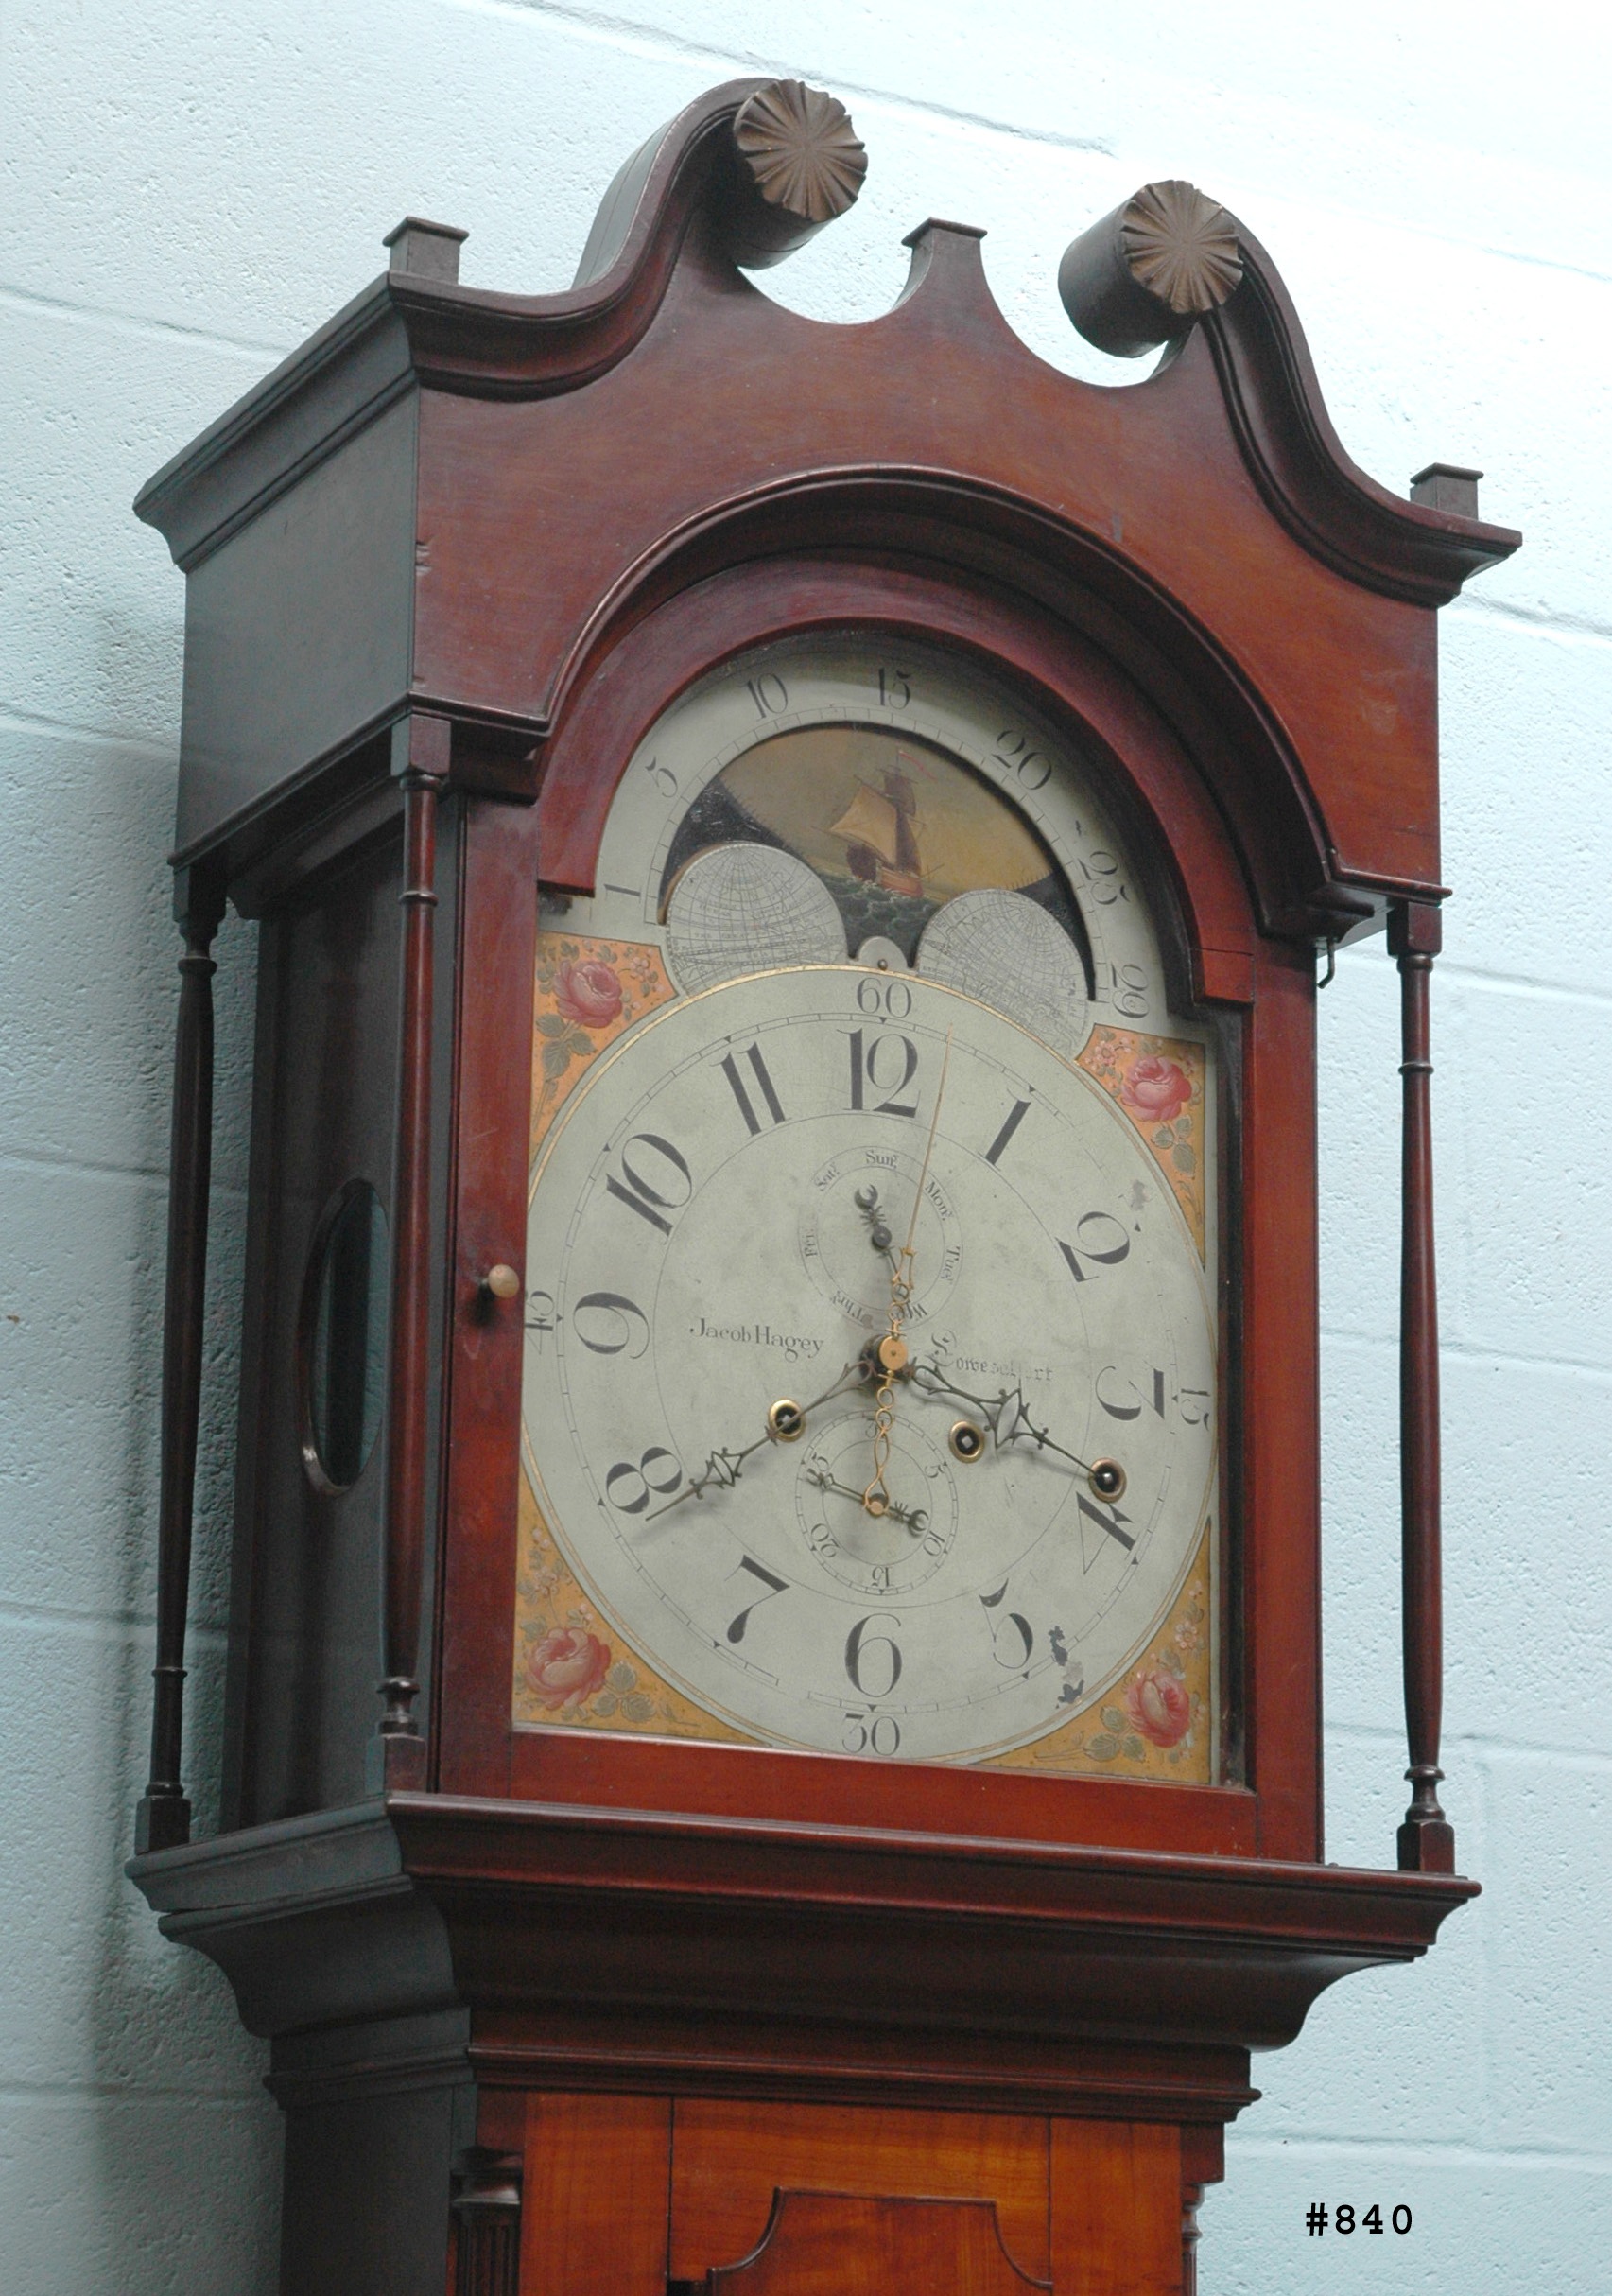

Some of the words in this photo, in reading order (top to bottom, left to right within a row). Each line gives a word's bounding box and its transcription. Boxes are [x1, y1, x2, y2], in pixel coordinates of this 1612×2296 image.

[746, 672, 789, 719] 10
[878, 668, 911, 710] 15
[645, 757, 679, 798] 5
[992, 729, 1052, 791] 20
[1079, 850, 1131, 906] 25
[857, 977, 912, 1018] 60
[709, 1042, 791, 1137] 11
[837, 1027, 921, 1119] 12
[978, 1088, 1031, 1171] 1
[601, 1133, 693, 1241] 10
[1055, 1210, 1131, 1283] 2
[572, 1291, 650, 1360] 9
[689, 1318, 752, 1342] Jacob
[755, 1325, 824, 1363] Hagey
[1096, 1359, 1165, 1421] 3
[606, 1446, 683, 1514] 8
[1076, 1491, 1136, 1575] 4
[723, 1554, 790, 1644] 7
[872, 1566, 891, 1587] 15
[844, 1613, 902, 1698] 6
[979, 1577, 1034, 1669] 5
[841, 1713, 901, 1756] 30
